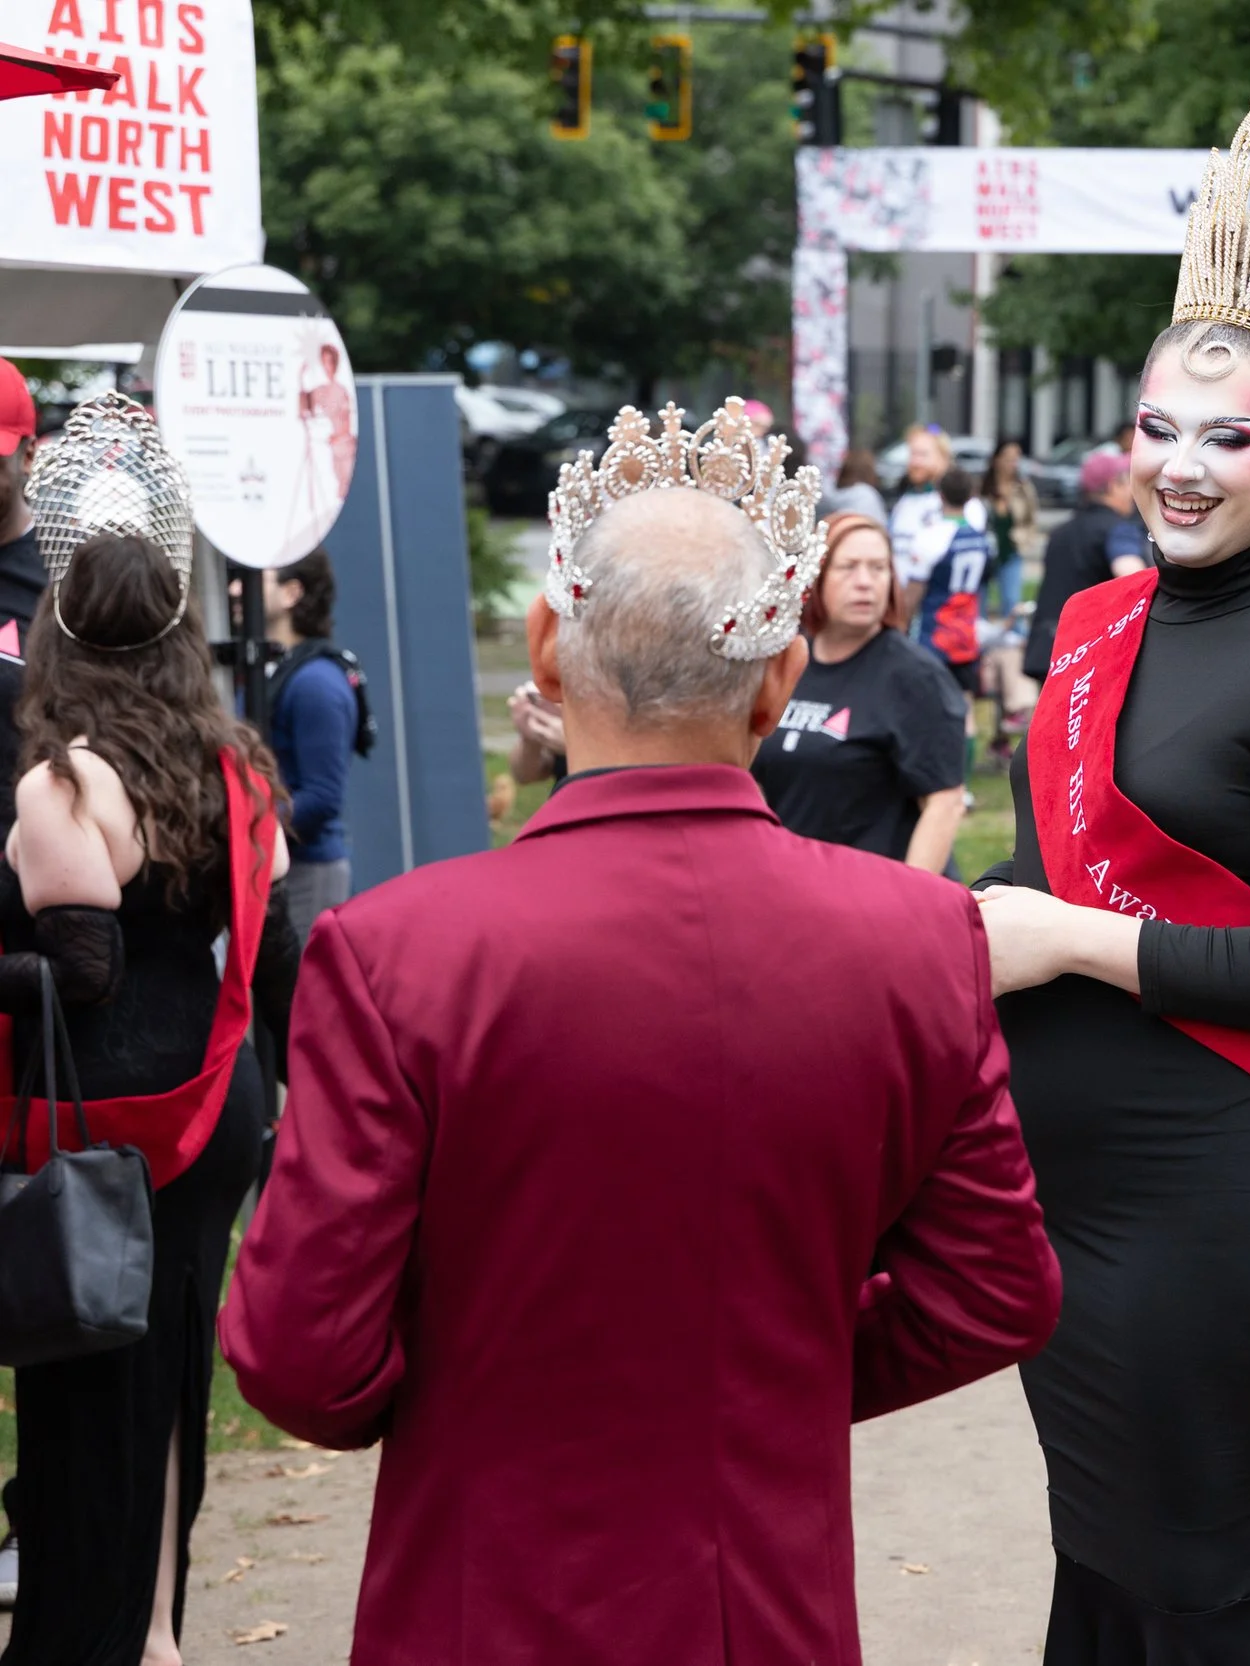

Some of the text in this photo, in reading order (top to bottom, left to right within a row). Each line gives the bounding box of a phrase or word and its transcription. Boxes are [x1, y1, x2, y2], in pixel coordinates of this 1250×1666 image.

[46, 0, 206, 55] AIDS
[43, 110, 212, 173] NORTH
[45, 170, 212, 236] WEST
[206, 359, 285, 399] LIFE
[1067, 666, 1095, 750] Miss
[1069, 760, 1087, 836] HIV
